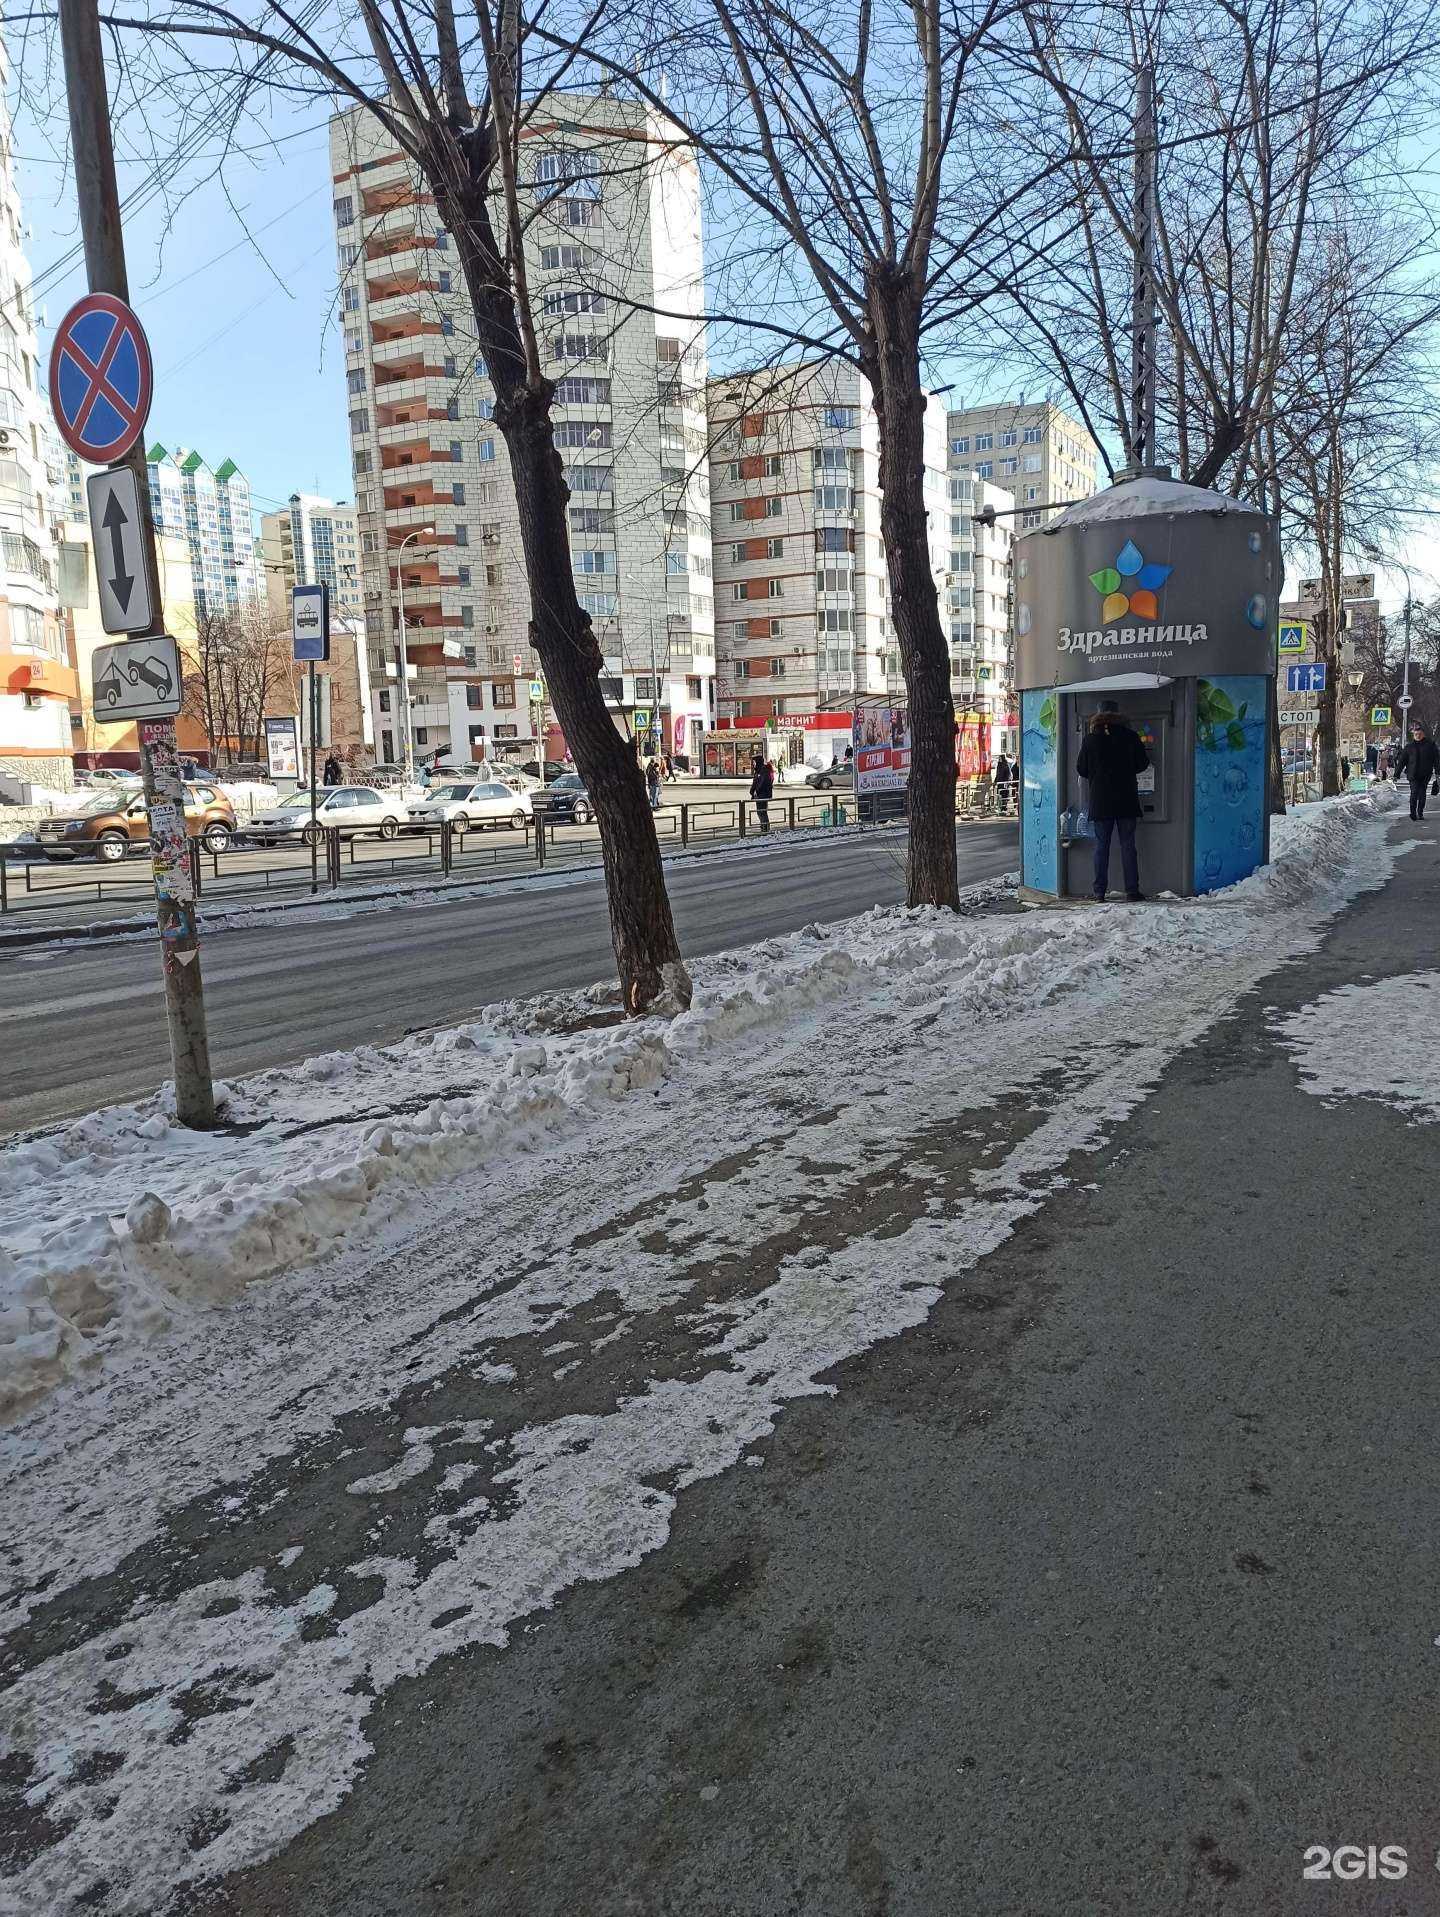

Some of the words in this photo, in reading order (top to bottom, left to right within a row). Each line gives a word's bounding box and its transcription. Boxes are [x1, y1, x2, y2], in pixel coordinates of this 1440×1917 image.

[1057, 623, 1208, 655] Здравница
[1088, 652, 1150, 663] артезианская
[1151, 650, 1173, 658] вода
[777, 715, 816, 726] магнит
[1280, 711, 1313, 722] СТОП
